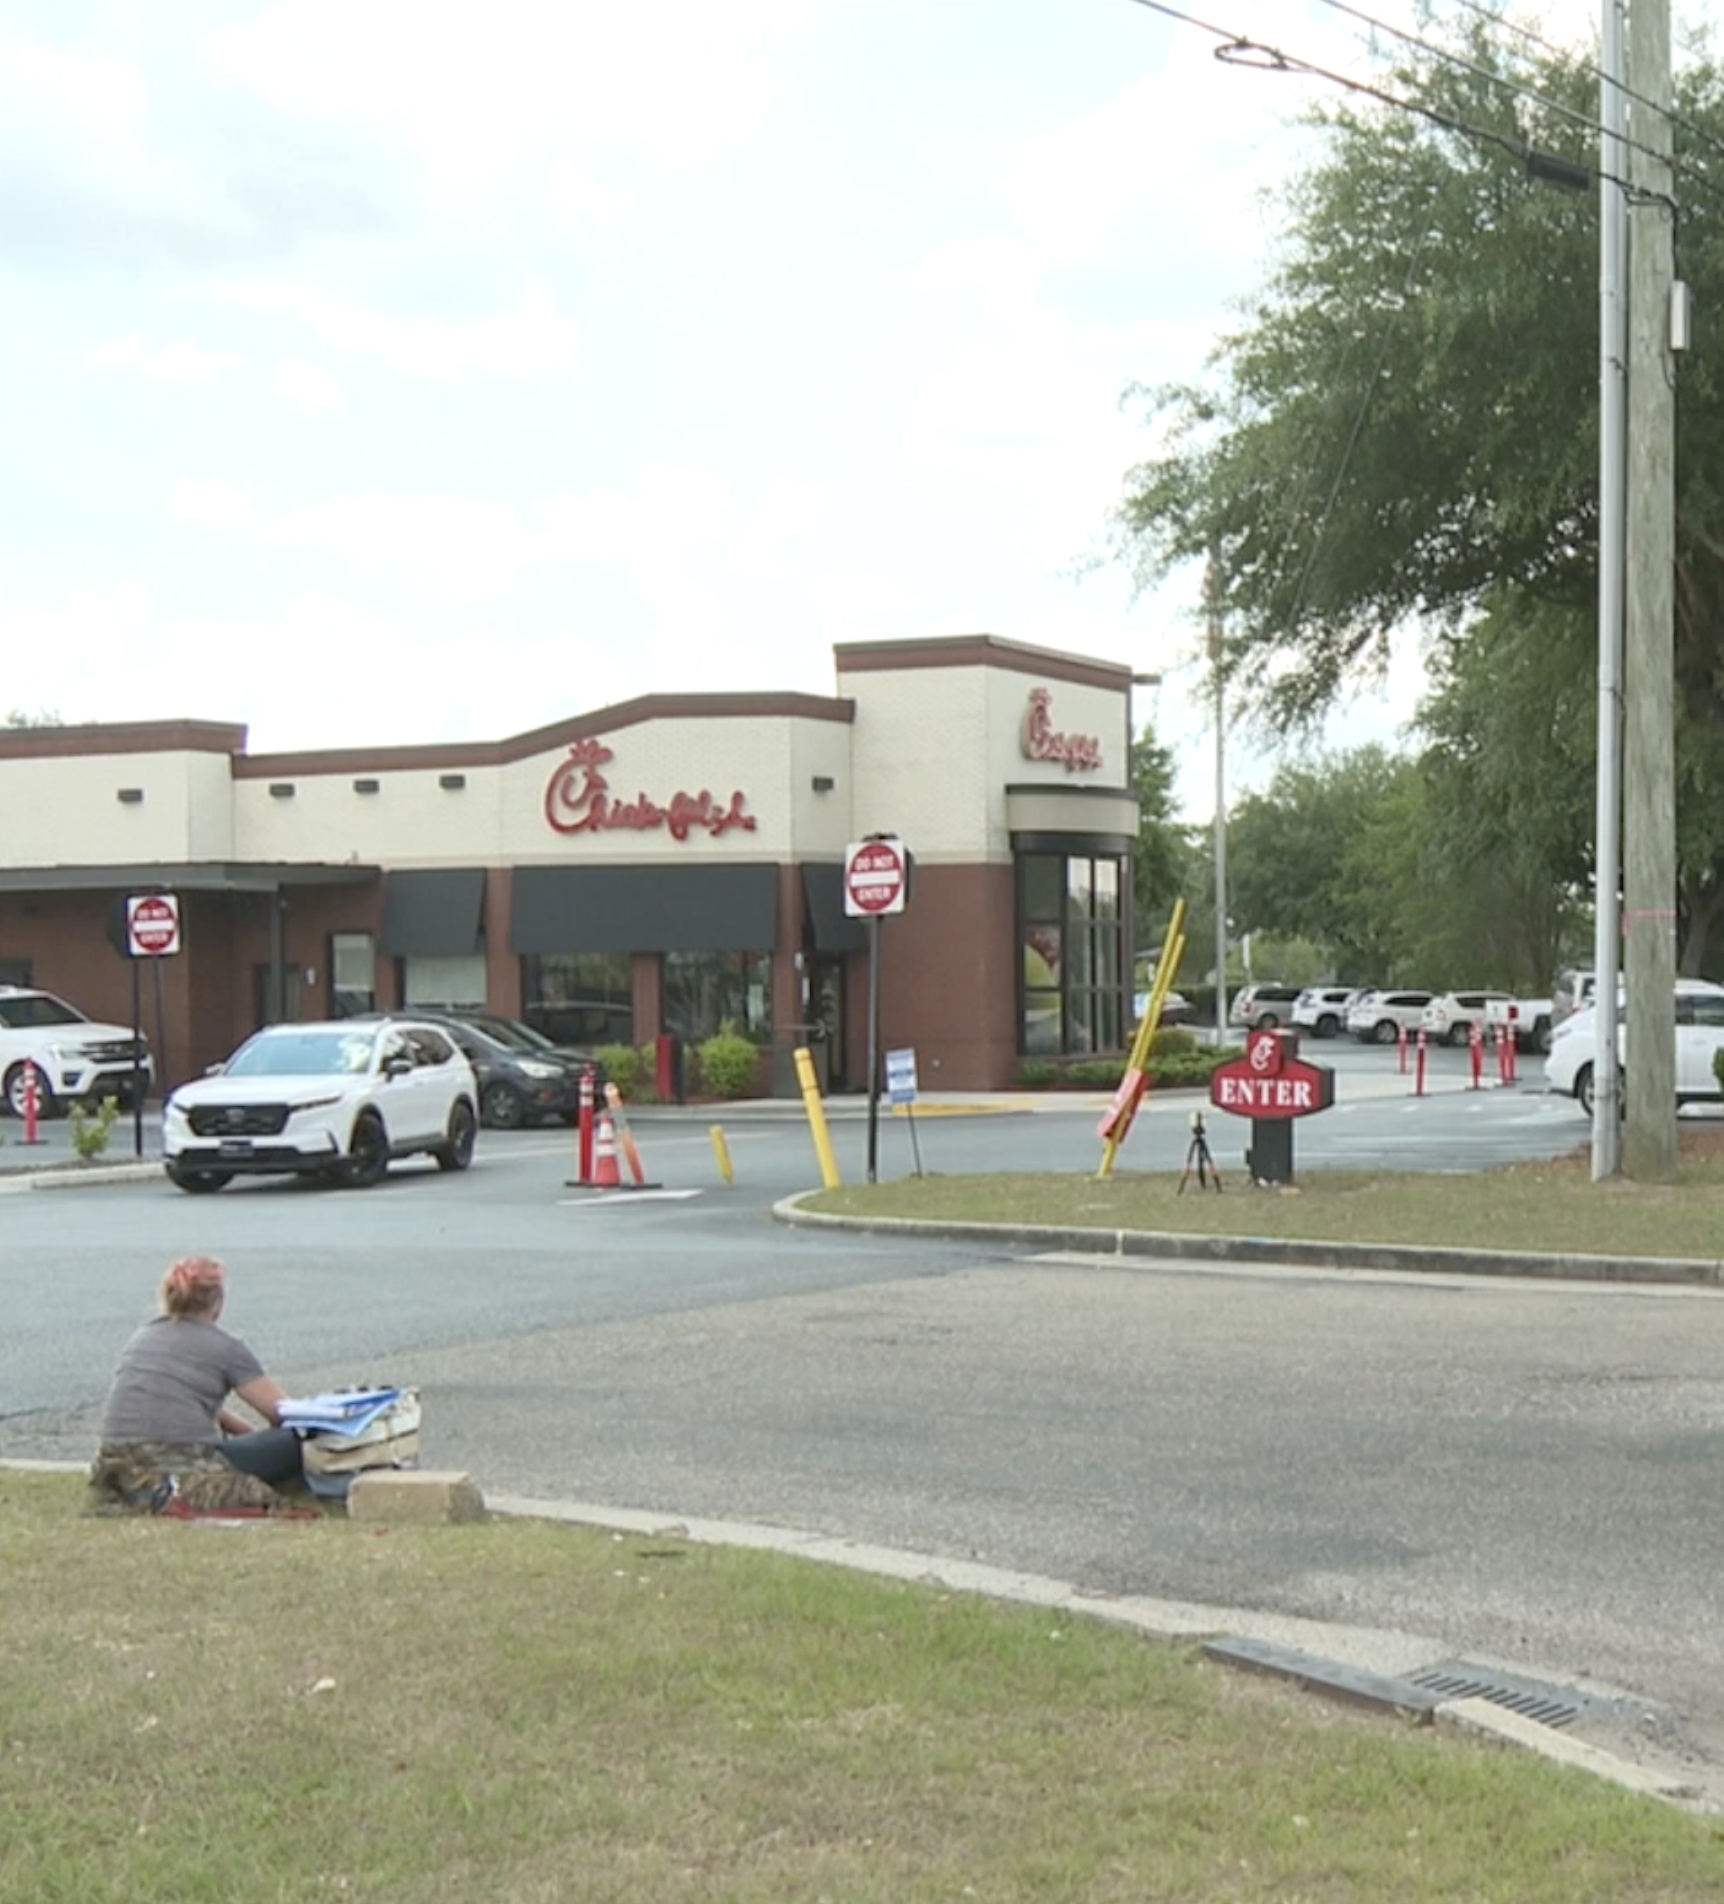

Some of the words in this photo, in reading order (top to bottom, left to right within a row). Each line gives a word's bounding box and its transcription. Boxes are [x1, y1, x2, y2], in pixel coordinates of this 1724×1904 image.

[855, 856, 871, 870] DO
[873, 854, 893, 868] NOT
[858, 886, 891, 902] ENTER
[1220, 1078, 1312, 1107] ENTER
